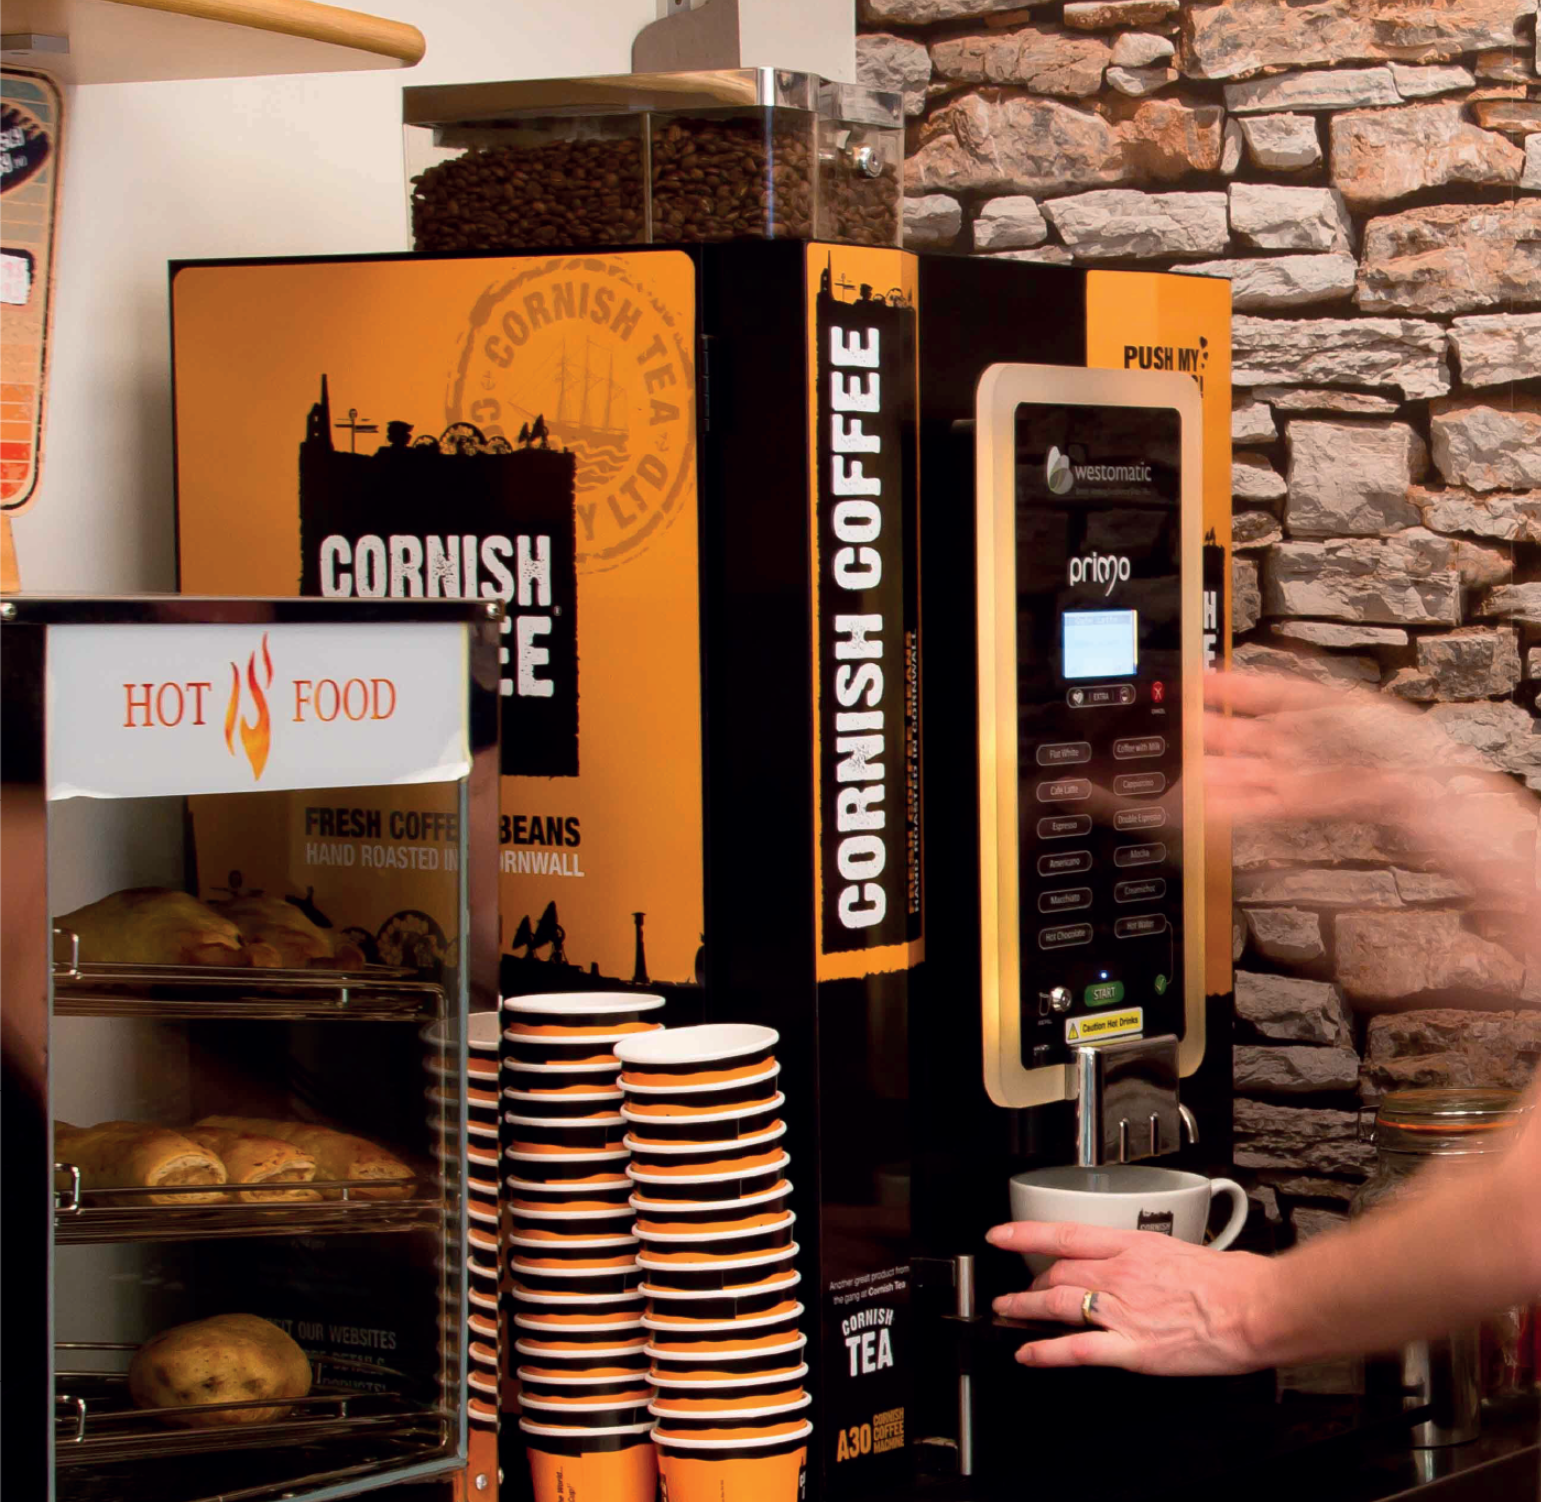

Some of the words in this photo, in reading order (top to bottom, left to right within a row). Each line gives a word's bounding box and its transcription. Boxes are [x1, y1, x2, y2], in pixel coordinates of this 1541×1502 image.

[485, 281, 643, 368] CORNISH
[1124, 345, 1174, 370] PUSH
[1178, 347, 1199, 372] MY
[637, 334, 681, 427] TEA
[831, 326, 882, 591] COFFEE
[1075, 460, 1152, 483] westomatic
[608, 454, 669, 529] LTD
[320, 534, 552, 606] CORNISH
[1070, 551, 1131, 597] primo
[122, 681, 212, 728] HOT
[291, 677, 397, 722] FOOD
[835, 613, 887, 930] CORNISH
[305, 807, 381, 839] FRESH
[389, 810, 459, 842] COFFE
[306, 842, 355, 867] HAND
[361, 844, 439, 871] ROASTED
[1093, 986, 1115, 1001] START
[1083, 1022, 1106, 1033] Caution
[1107, 1019, 1118, 1029] Hot
[1120, 1016, 1139, 1027] Drinks
[868, 1282, 894, 1297] Cornish
[894, 1280, 906, 1291] Tea
[329, 1324, 397, 1350] WEBSITES
[841, 1307, 895, 1337] CORNISH
[845, 1328, 894, 1377] TEA
[837, 1423, 872, 1462] A30
[873, 1420, 904, 1441] COFFEE
[873, 1434, 904, 1455] MACHINE
